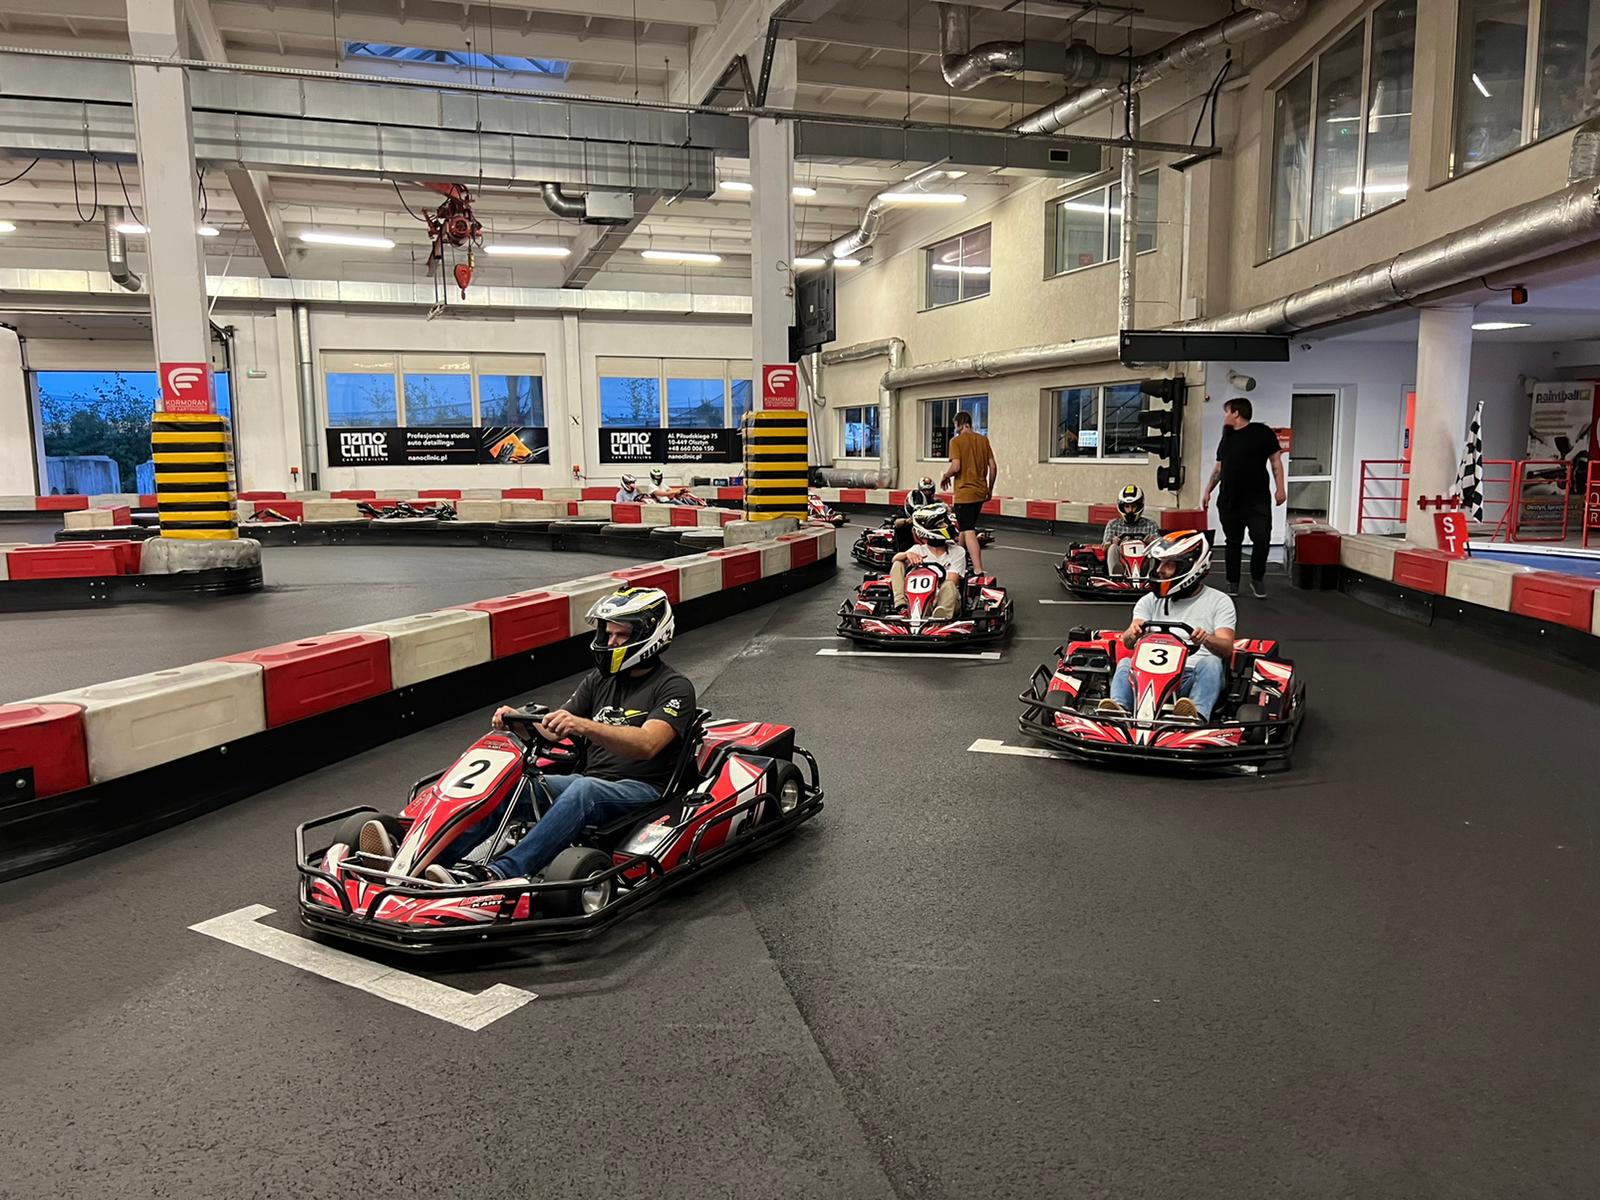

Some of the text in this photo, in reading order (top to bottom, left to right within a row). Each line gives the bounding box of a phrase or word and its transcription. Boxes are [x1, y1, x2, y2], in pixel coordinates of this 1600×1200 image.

[1536, 390, 1579, 403] paintball
[406, 432, 450, 440] Profesjonalne
[341, 445, 388, 457] CLINIC
[611, 444, 652, 455] CLINIC
[407, 454, 448, 462] nanoclinic.pl
[1129, 546, 1137, 554] 1
[910, 577, 931, 590] 10
[1149, 648, 1168, 666] 3
[452, 759, 491, 789] 2
[472, 900, 502, 908] KART
